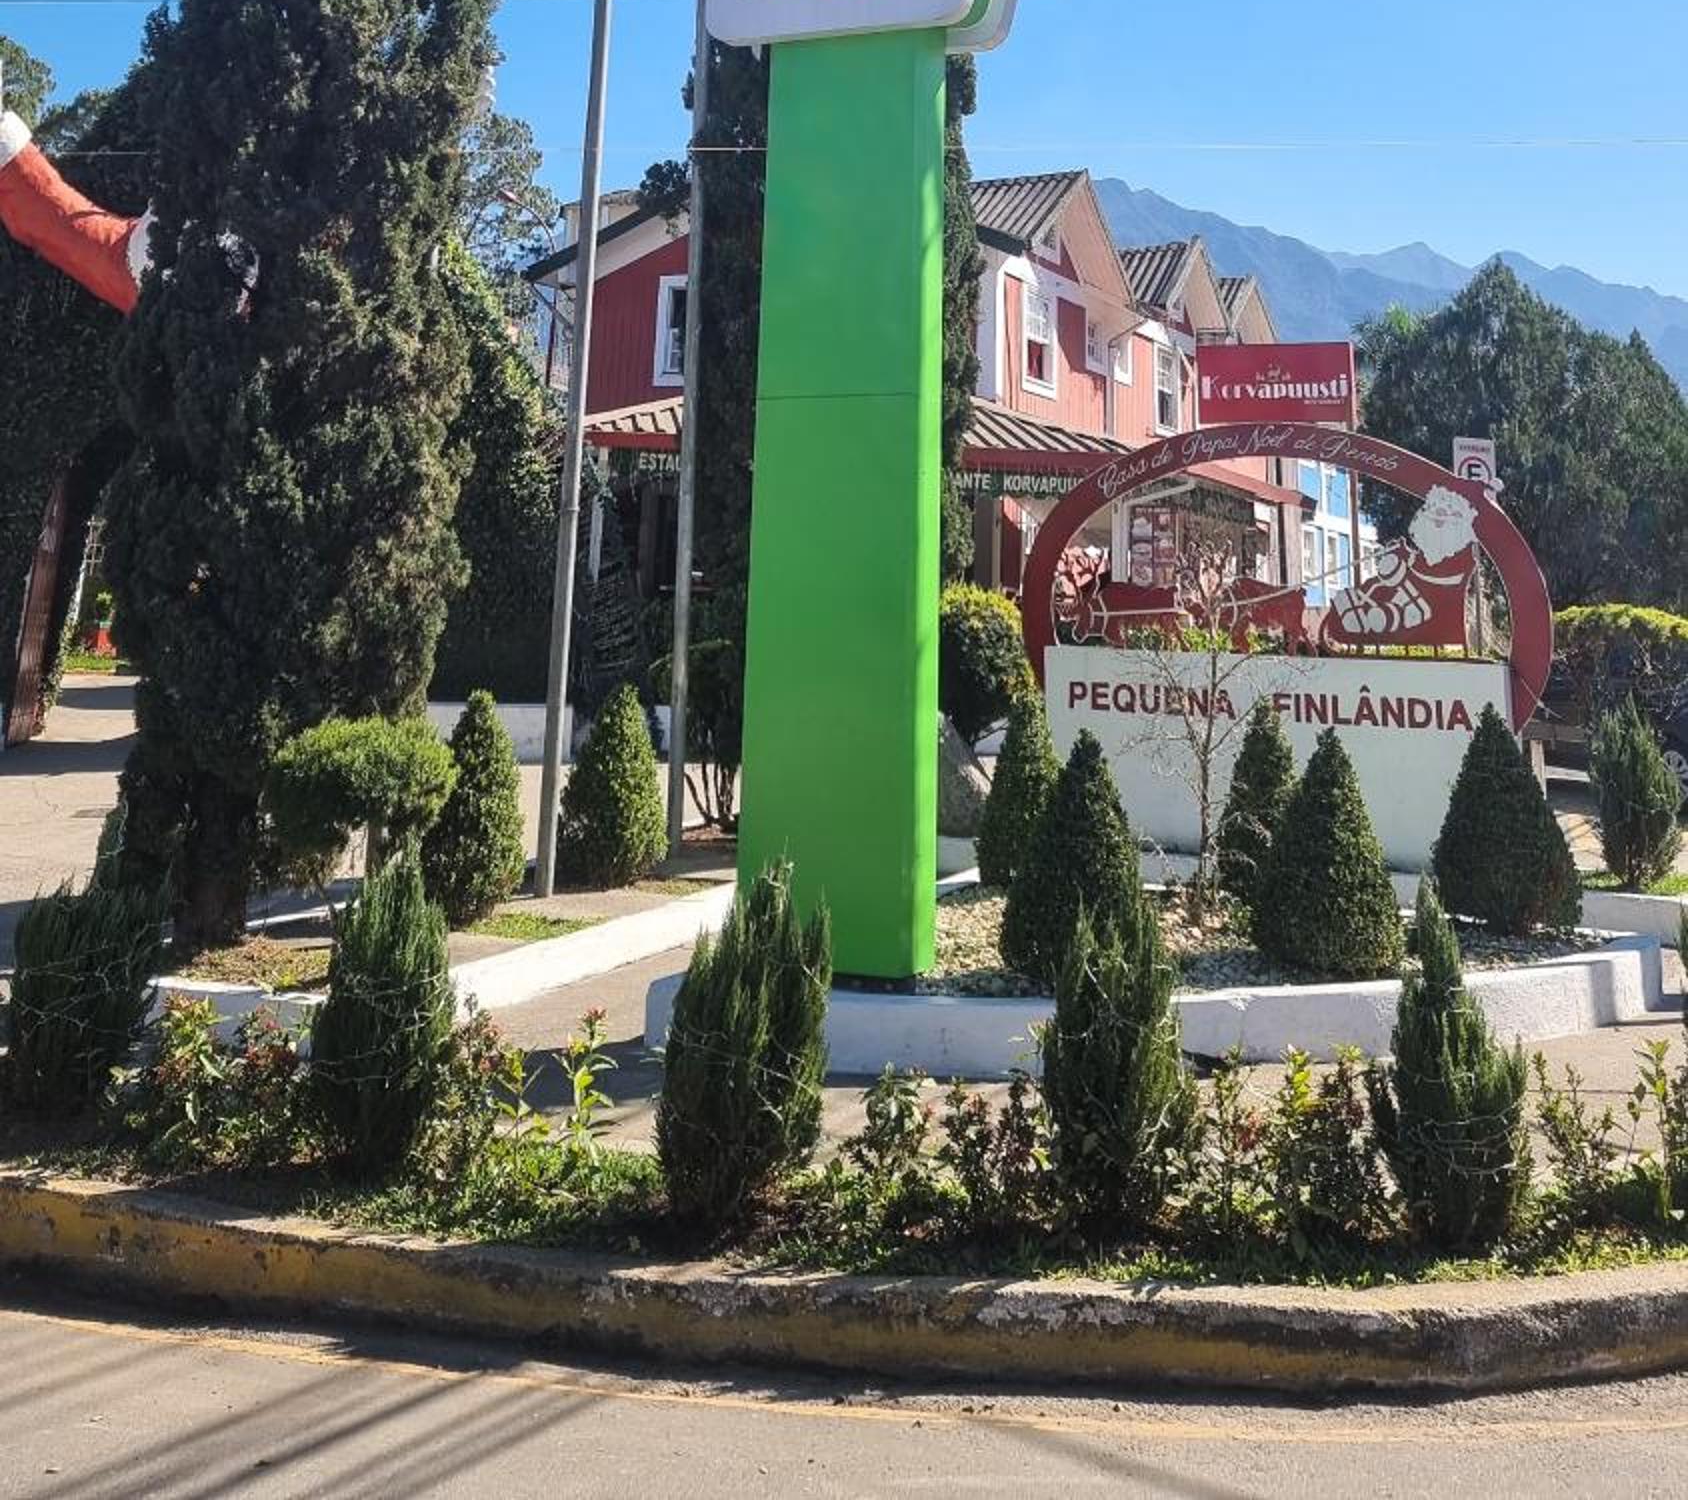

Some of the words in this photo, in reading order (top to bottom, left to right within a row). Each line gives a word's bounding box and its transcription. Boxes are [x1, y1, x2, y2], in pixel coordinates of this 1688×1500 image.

[1201, 373, 1349, 399] Korvapuusti
[946, 472, 992, 490] ANTE
[1097, 459, 1149, 499] Casa
[1151, 443, 1175, 469] de
[1181, 433, 1240, 465] Papai
[1294, 434, 1317, 451] de
[1318, 434, 1400, 471] Penedo
[1271, 684, 1473, 731] FINLÂNDIA
